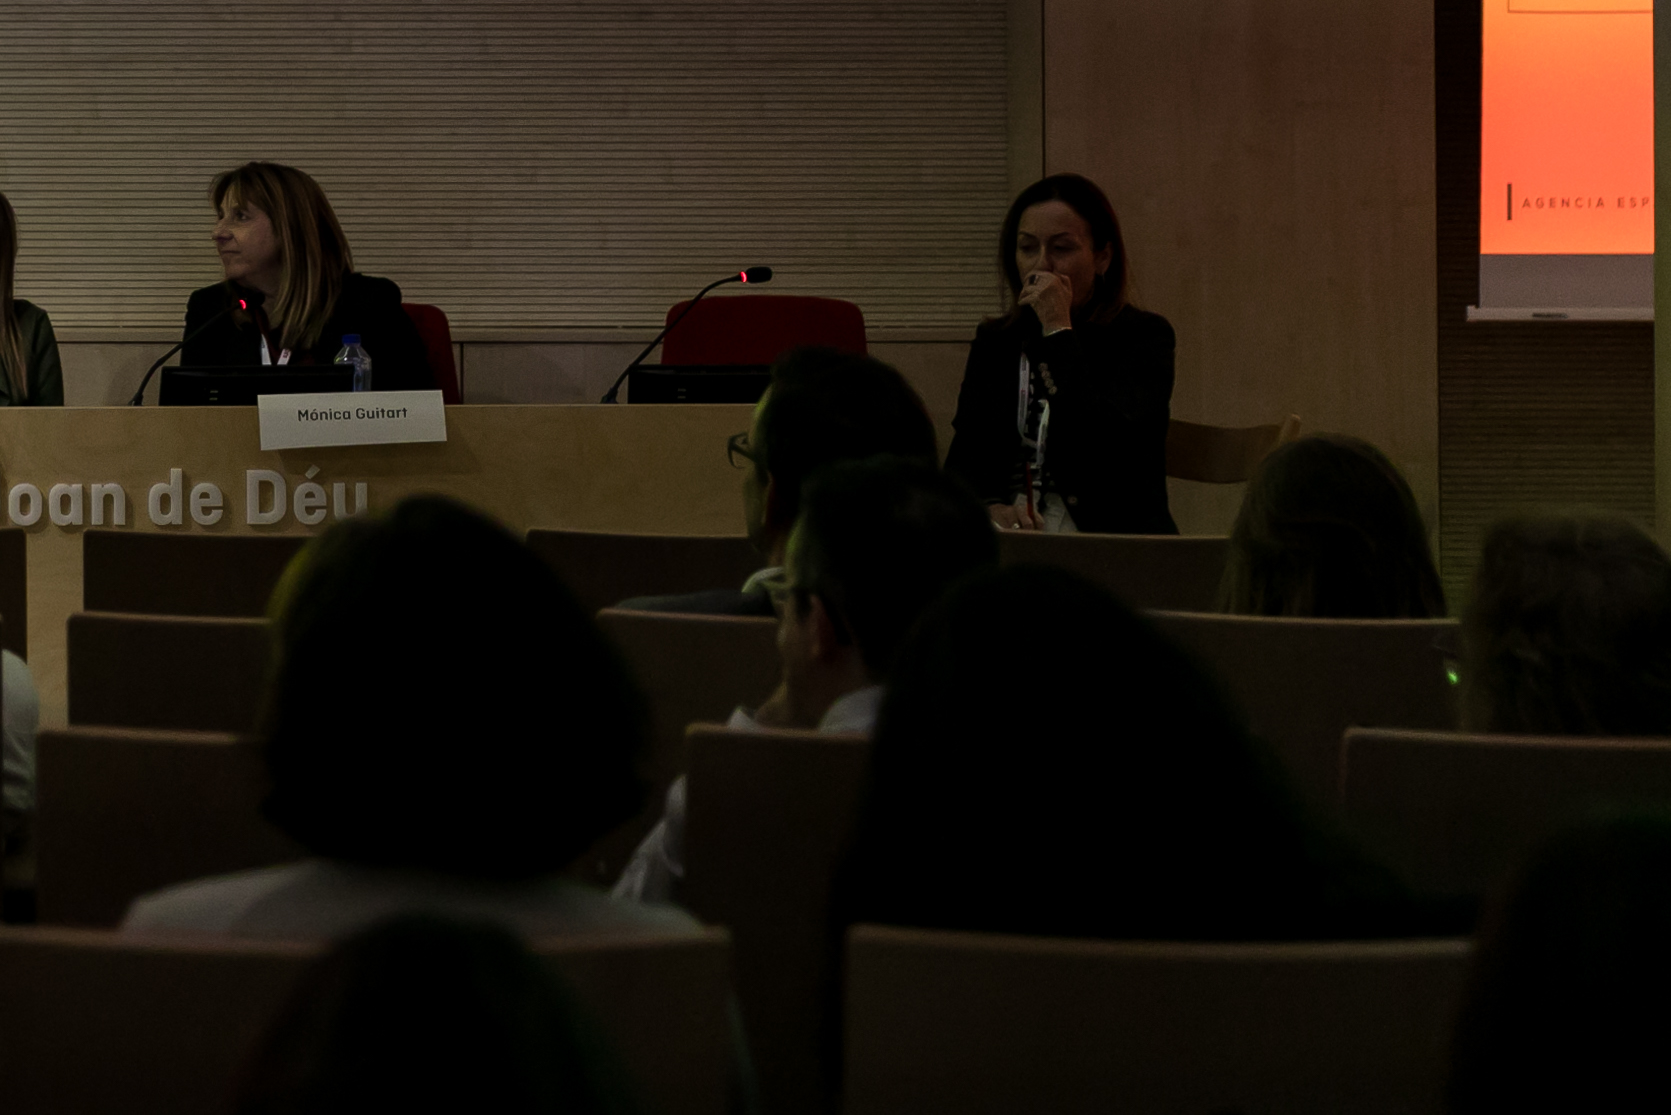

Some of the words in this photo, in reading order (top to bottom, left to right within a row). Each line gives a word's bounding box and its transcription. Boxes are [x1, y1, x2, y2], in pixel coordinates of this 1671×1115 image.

[1522, 196, 1605, 209] AGENCIA
[1617, 196, 1650, 209] ESP
[297, 408, 351, 422] Mónica
[355, 407, 408, 420] Guitart
[148, 468, 224, 526] de
[246, 464, 368, 526] Déu
